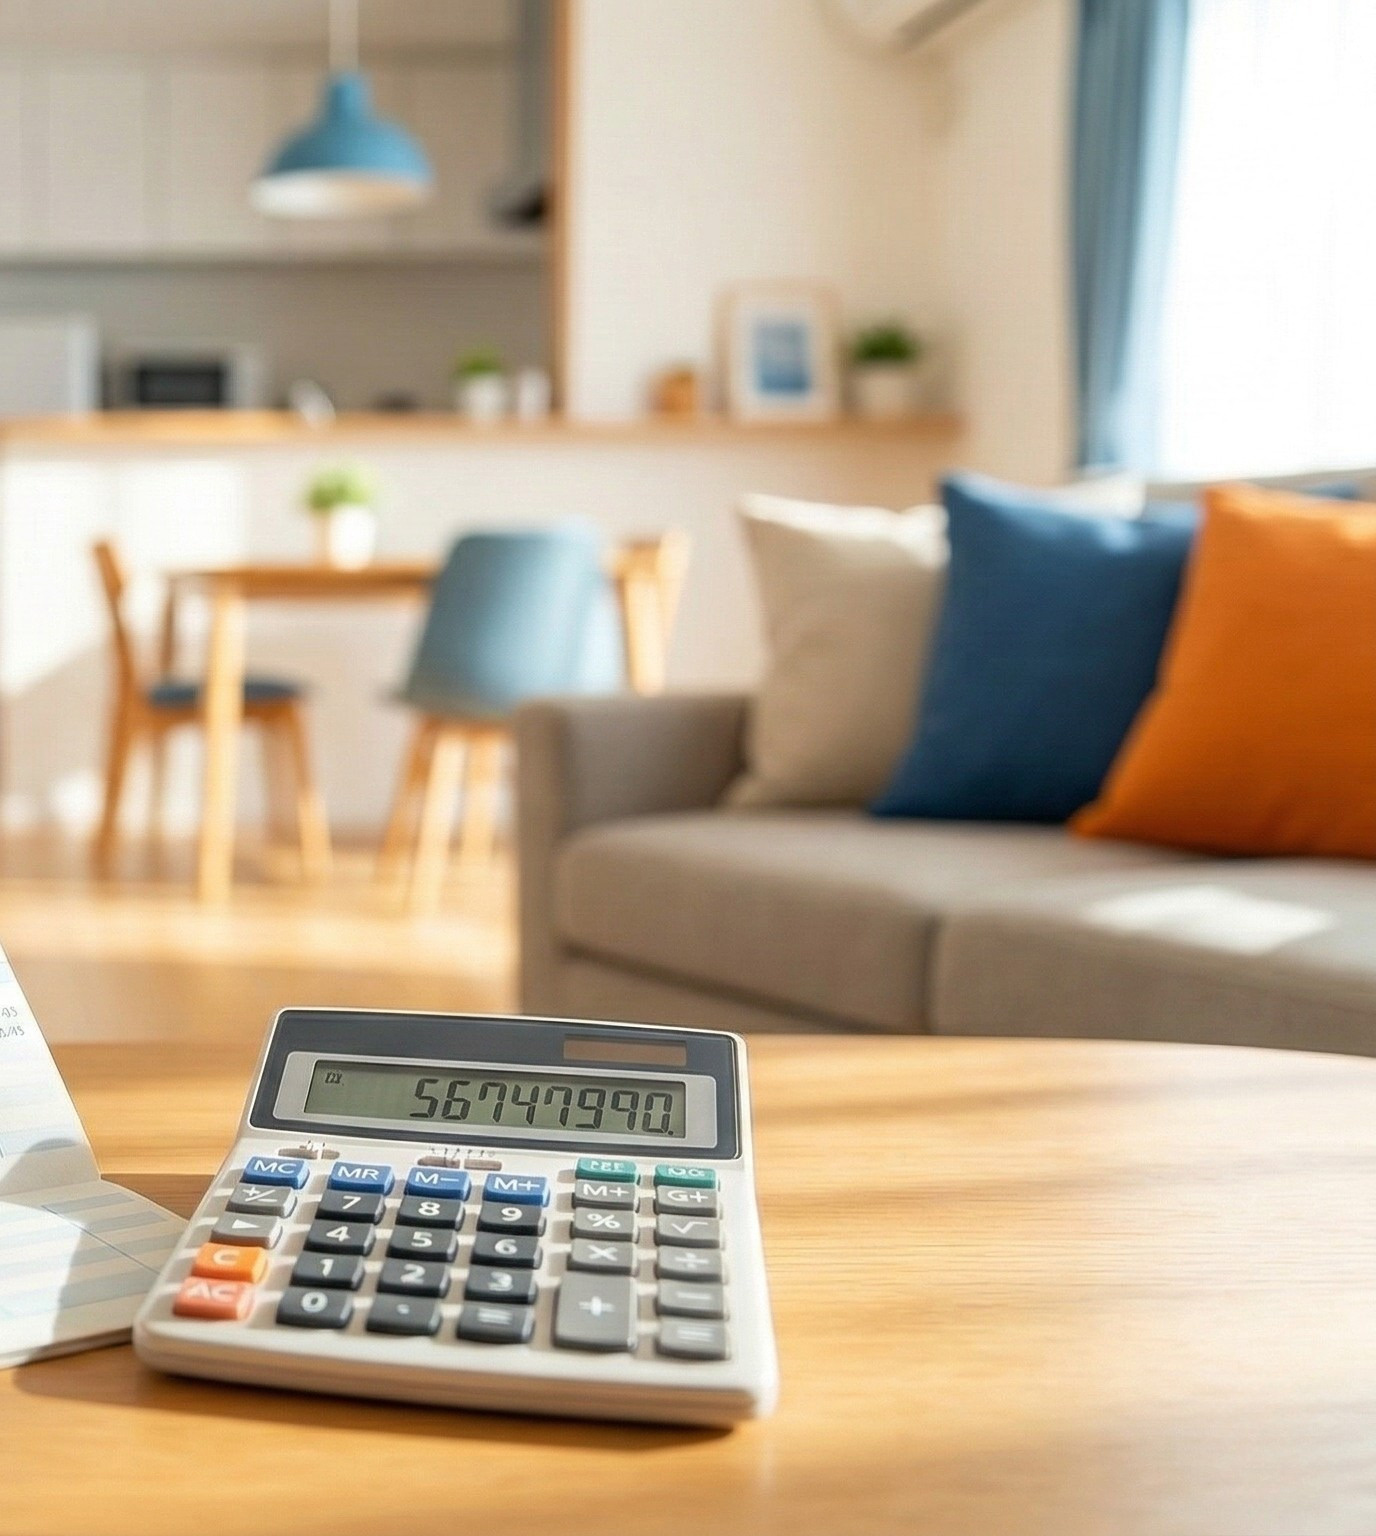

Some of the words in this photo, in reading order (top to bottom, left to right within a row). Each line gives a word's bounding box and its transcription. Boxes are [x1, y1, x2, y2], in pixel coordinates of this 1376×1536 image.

[253, 1159, 297, 1174] MC
[337, 1166, 379, 1181] MR
[494, 1177, 540, 1192] M+
[583, 1184, 630, 1197] M+
[342, 1195, 362, 1210] 7
[667, 1190, 709, 1203] G+
[418, 1201, 441, 1216] 8
[501, 1207, 523, 1222] 9
[586, 1213, 621, 1229] %
[326, 1225, 351, 1242] 4
[411, 1231, 433, 1247] 5
[494, 1238, 518, 1255] 6
[212, 1250, 240, 1266] C
[320, 1258, 334, 1277] 1
[400, 1263, 426, 1285] 2
[488, 1271, 514, 1292] 3
[186, 1280, 231, 1300] AC
[301, 1291, 328, 1313] 0
